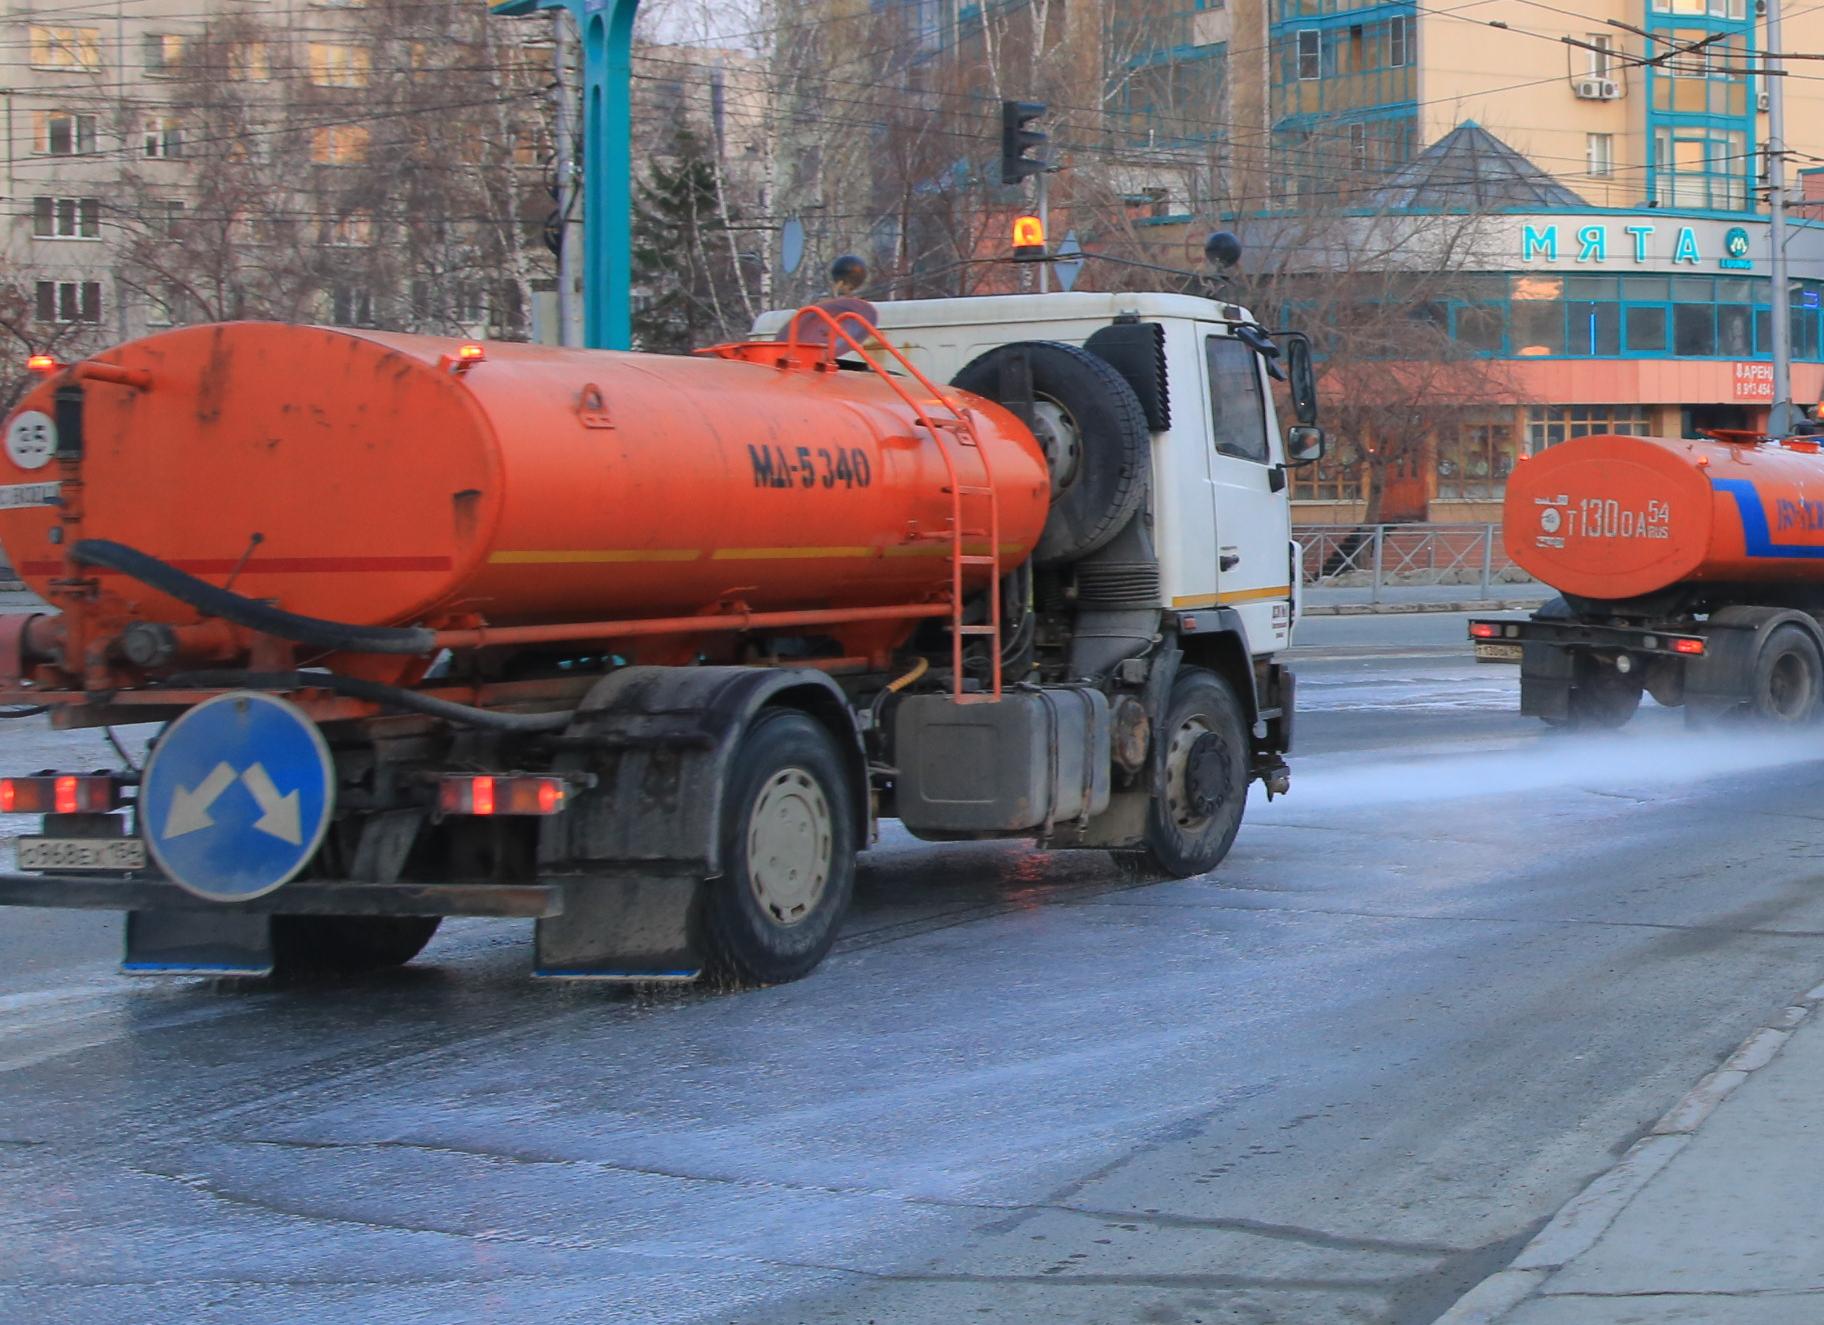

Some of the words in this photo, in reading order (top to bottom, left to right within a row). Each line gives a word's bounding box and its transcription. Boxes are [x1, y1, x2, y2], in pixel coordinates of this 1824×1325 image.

[1522, 224, 1701, 265] МЯТА
[1648, 500, 1670, 523] 54
[1648, 526, 1669, 538] RUS
